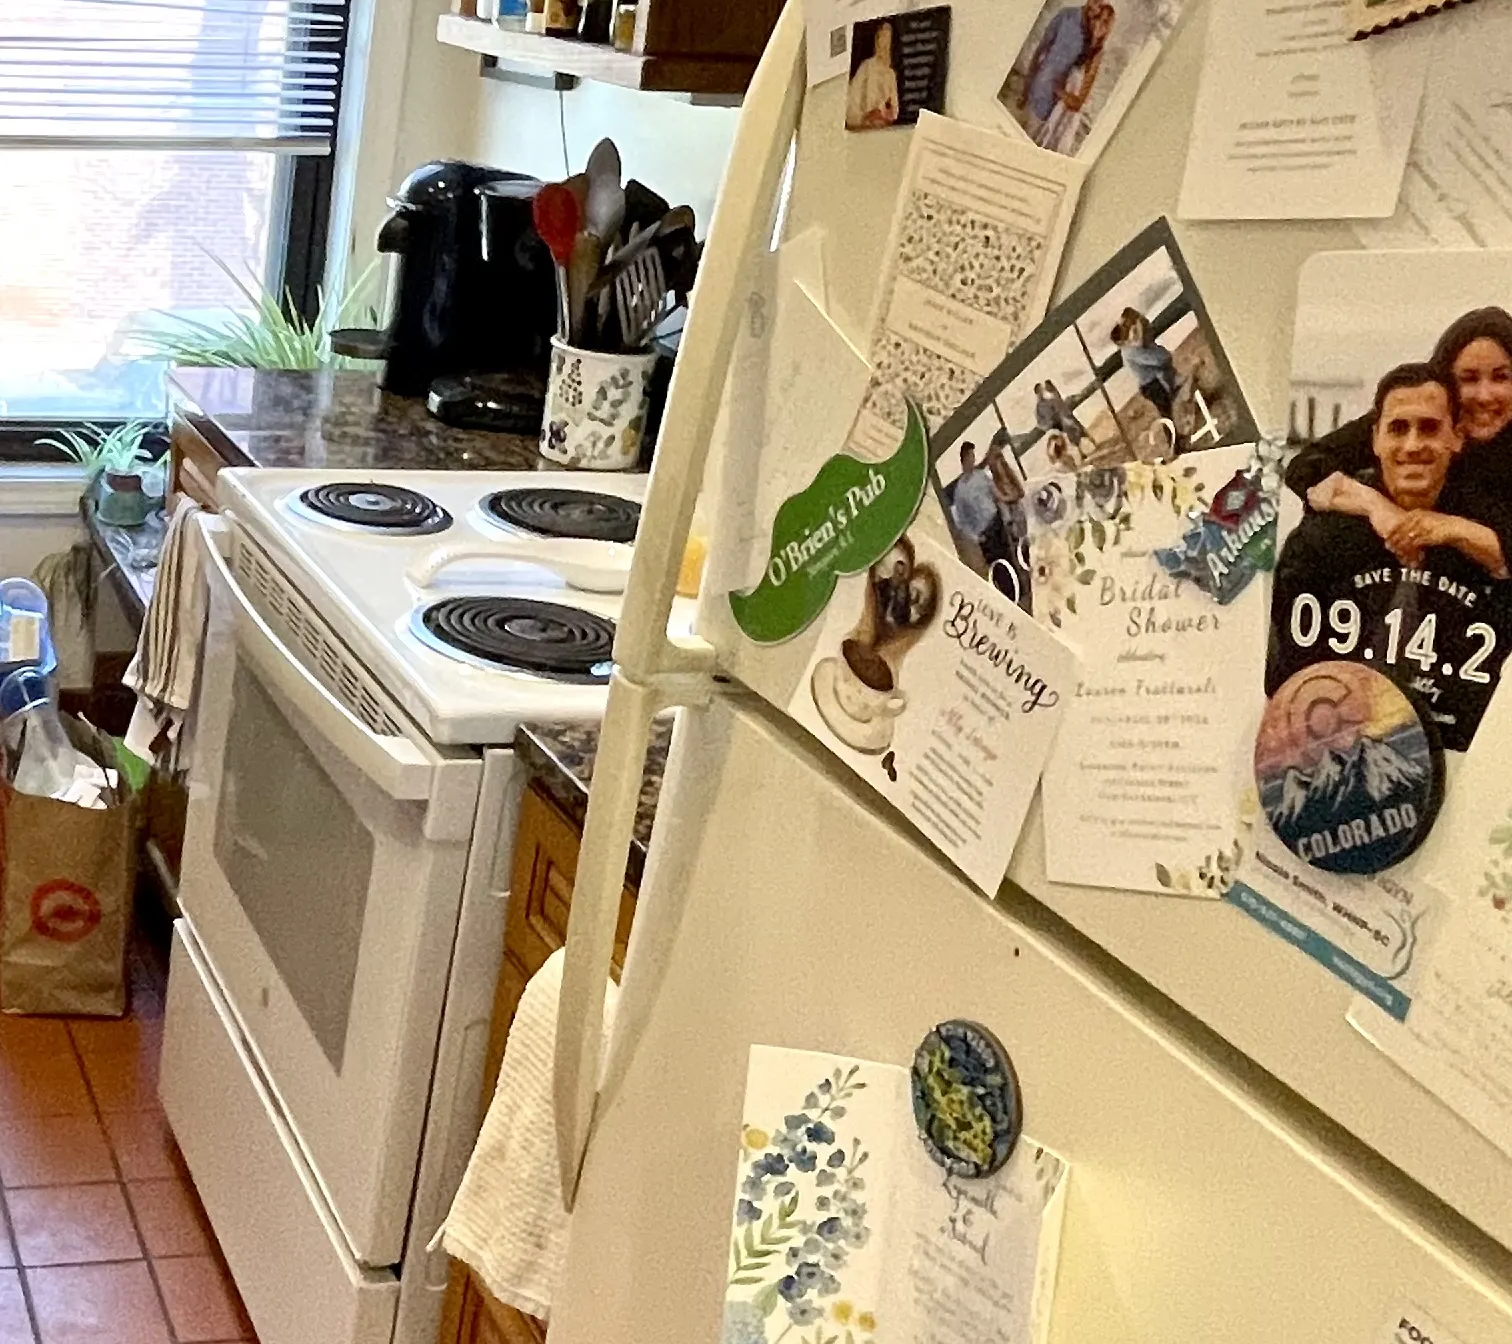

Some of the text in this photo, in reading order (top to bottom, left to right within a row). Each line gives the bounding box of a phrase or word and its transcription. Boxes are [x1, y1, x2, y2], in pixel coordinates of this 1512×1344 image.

[768, 505, 848, 587] O'Brien's
[845, 467, 887, 519] Pub
[1099, 572, 1182, 607] Bridal
[1353, 567, 1478, 609] SAVE THE DATE
[1126, 605, 1221, 638] Shower
[943, 590, 1060, 714] Brewing
[1296, 803, 1418, 864] COLORADO
